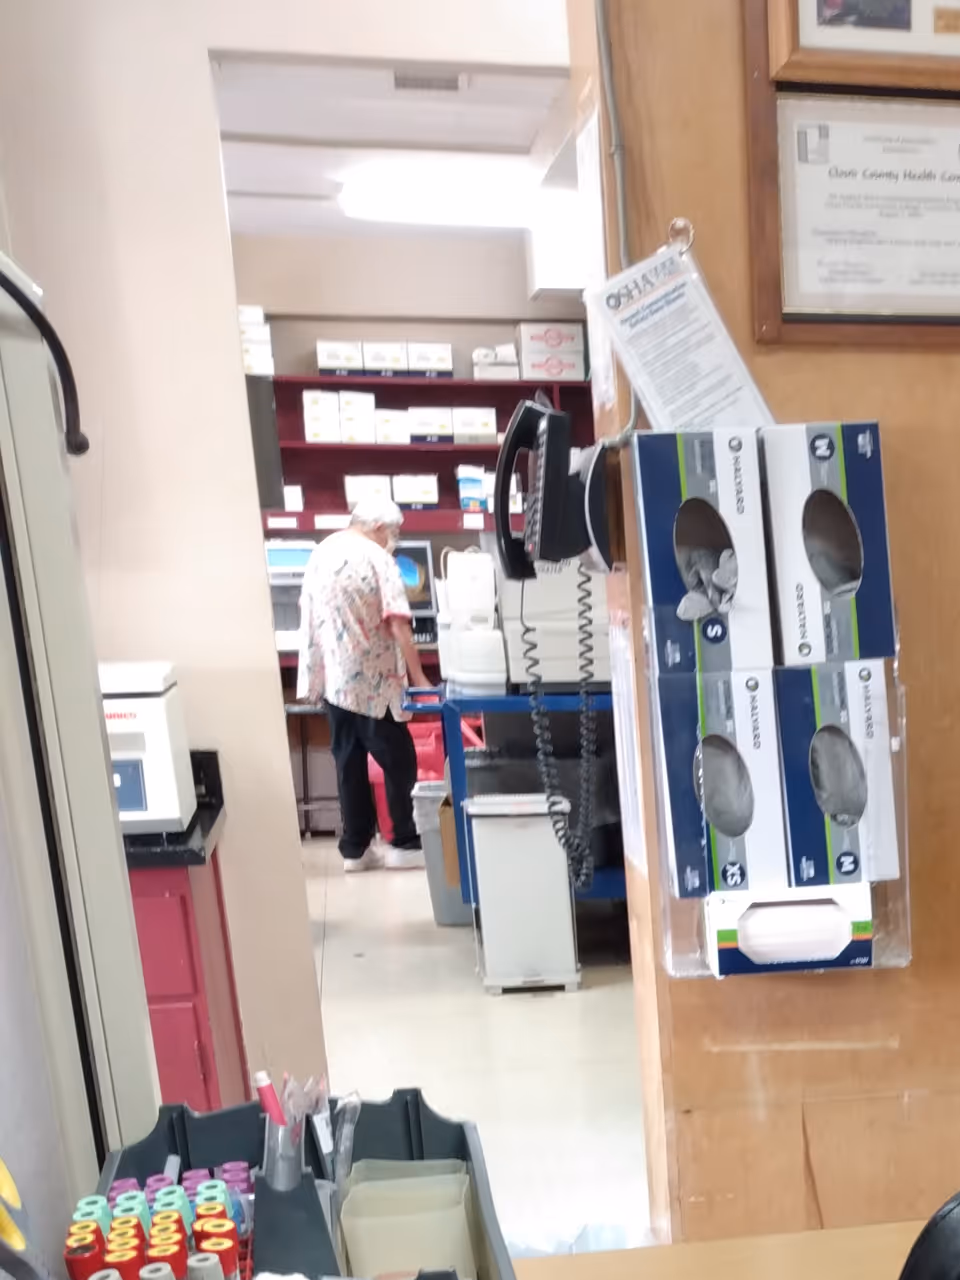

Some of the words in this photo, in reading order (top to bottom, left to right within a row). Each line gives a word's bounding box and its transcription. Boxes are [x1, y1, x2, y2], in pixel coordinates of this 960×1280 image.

[903, 167, 936, 182] Health
[731, 454, 745, 515] HALYARD
[706, 624, 722, 638] S
[840, 856, 856, 872] M
[725, 864, 742, 886] XS
